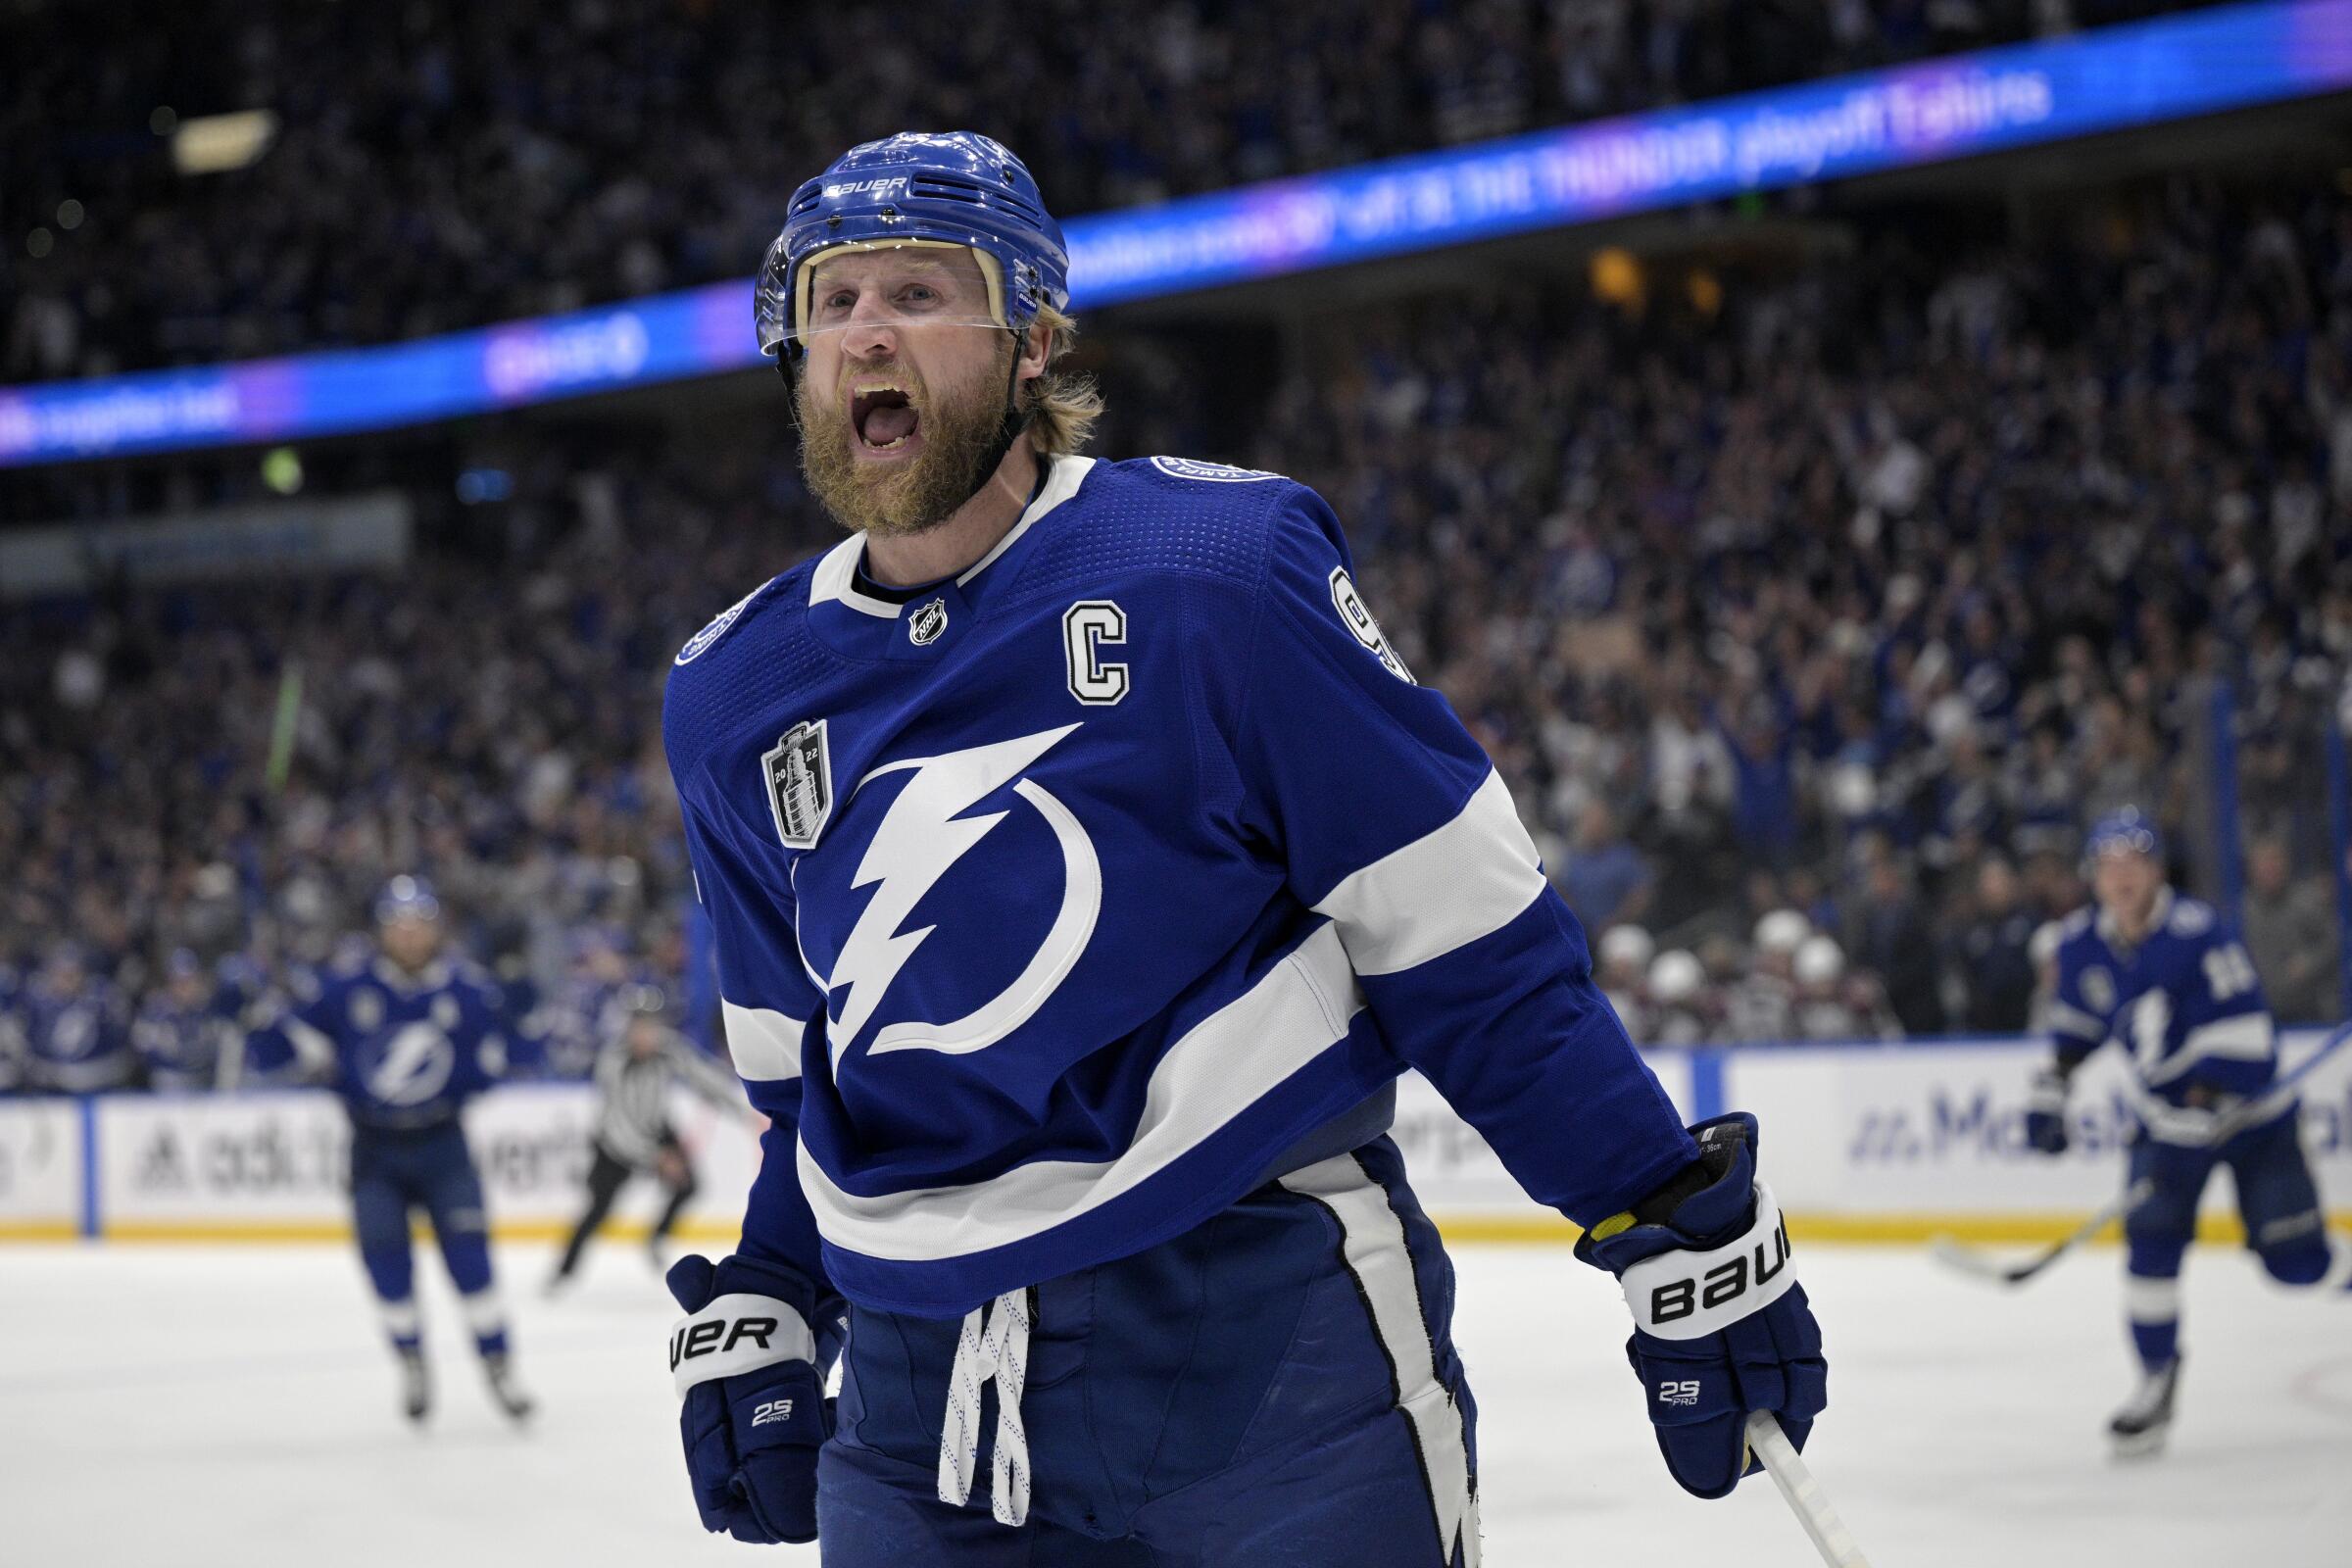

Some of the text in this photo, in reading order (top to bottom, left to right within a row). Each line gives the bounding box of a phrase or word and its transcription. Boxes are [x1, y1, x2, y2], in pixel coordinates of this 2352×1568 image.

[822, 176, 907, 197] BAUER
[1177, 466, 1241, 478] TAMPA
[918, 610, 939, 638] NHL
[1329, 565, 1417, 686] 9
[1062, 600, 1130, 706] C
[774, 747, 819, 784] 20 22
[1671, 1396, 1698, 1407] PRO
[766, 1413, 790, 1424] PRO
